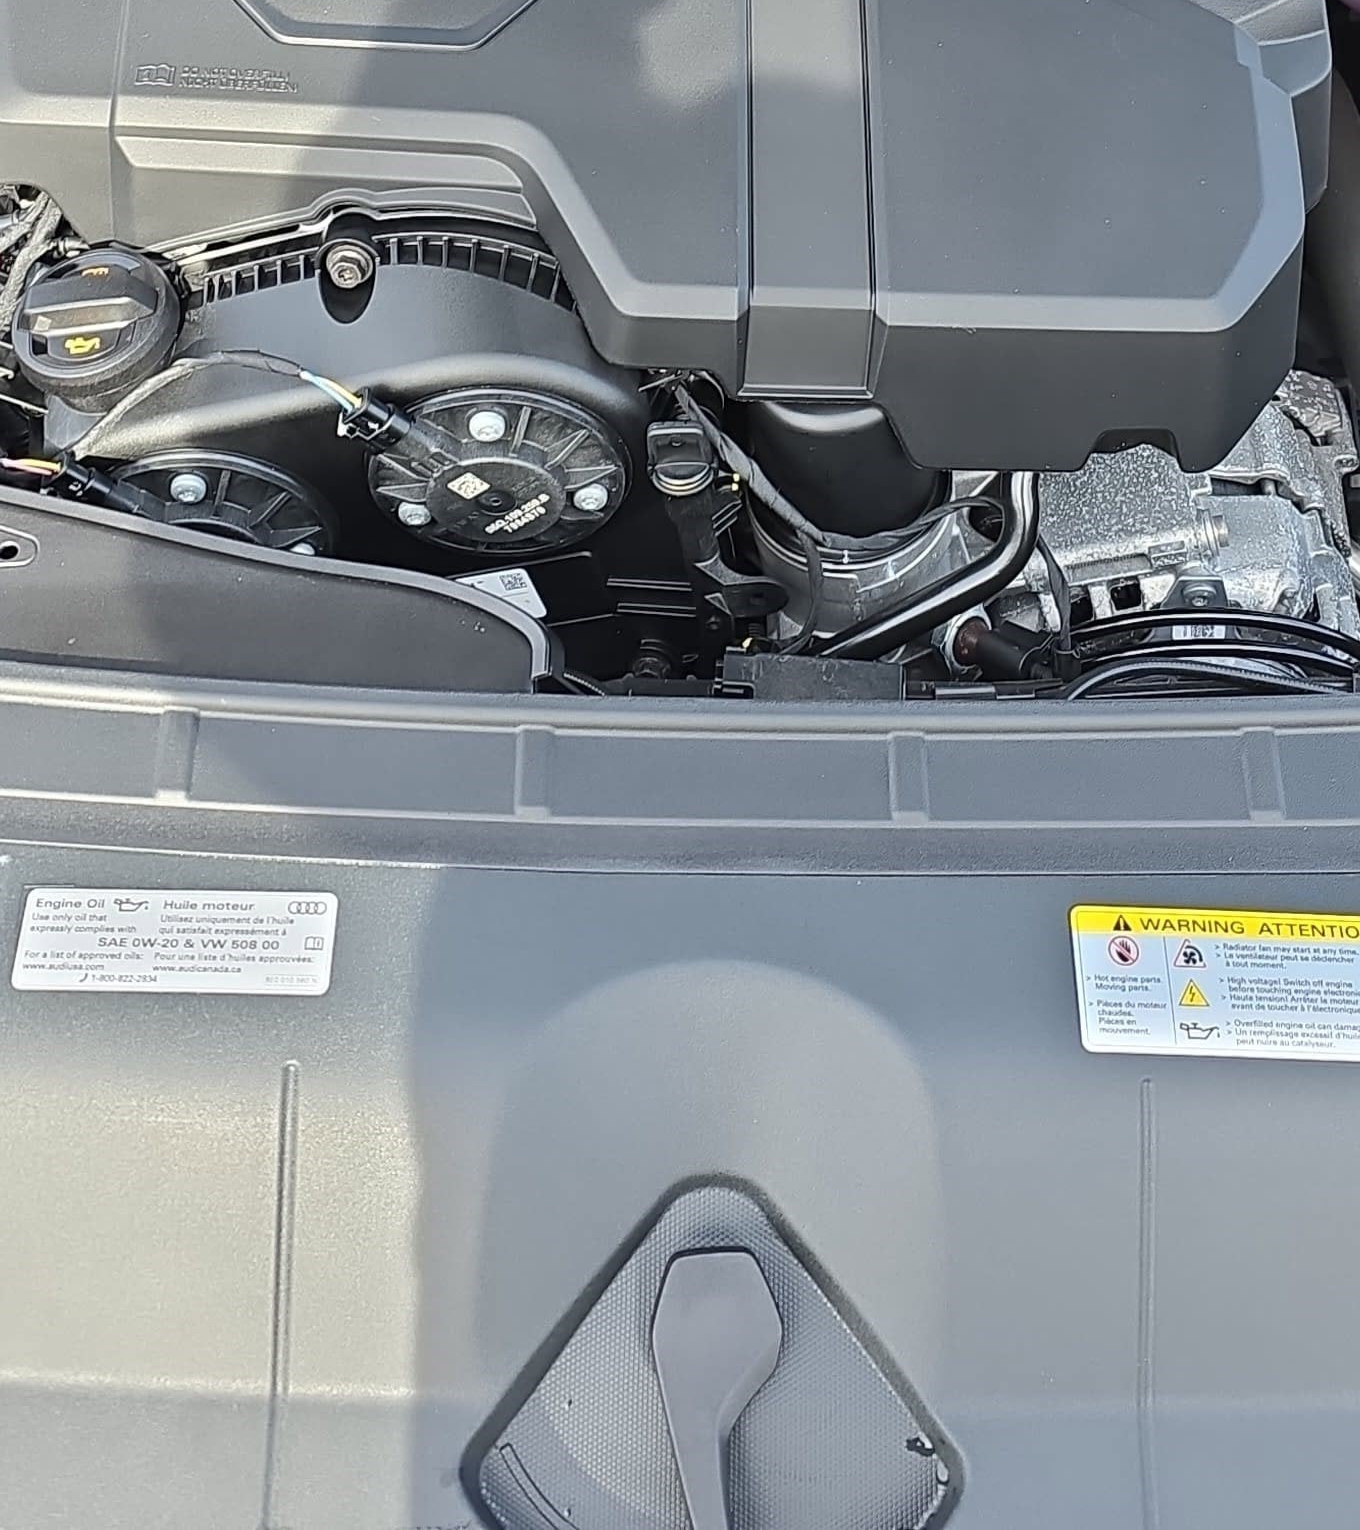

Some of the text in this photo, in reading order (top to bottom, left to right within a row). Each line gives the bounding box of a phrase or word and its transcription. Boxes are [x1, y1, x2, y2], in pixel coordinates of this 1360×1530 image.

[36, 898, 105, 909] Engine Oil
[163, 900, 255, 911] Huile moteur
[52, 914, 72, 922] only
[161, 915, 193, 923] Utilisez
[196, 917, 251, 925] uniquement
[30, 925, 136, 934] expressly complies with
[159, 926, 173, 935] qui
[176, 927, 212, 935] satisfait
[1140, 918, 1245, 935] WARNING
[98, 937, 279, 950] SAE 0W-20 & VW 508 00
[1223, 943, 1256, 951] Radiator
[24, 950, 40, 958] For
[50, 951, 64, 959] list
[66, 951, 76, 959] of
[78, 951, 122, 961] approved
[124, 951, 143, 960] oils:
[198, 953, 216, 961] liste
[23, 962, 104, 971] www.audiusa.com
[152, 964, 241, 973] www.audicanada.ca
[1094, 974, 1109, 982] Hot
[1095, 983, 1151, 992] Moving parts.
[1227, 977, 1246, 985] High
[1283, 978, 1311, 986] Switch
[1325, 981, 1352, 989] engine
[1256, 986, 1291, 995] touching
[1294, 988, 1322, 997] engine
[1234, 1019, 1273, 1028] Overfilled
[1276, 1021, 1303, 1030] engine
[1099, 1027, 1150, 1035] mouvement.
[1250, 1030, 1298, 1038] remplissage
[1236, 1038, 1254, 1046] peut
[1257, 1038, 1277, 1046] nuire
[1292, 1039, 1335, 1048] catalyseur.
